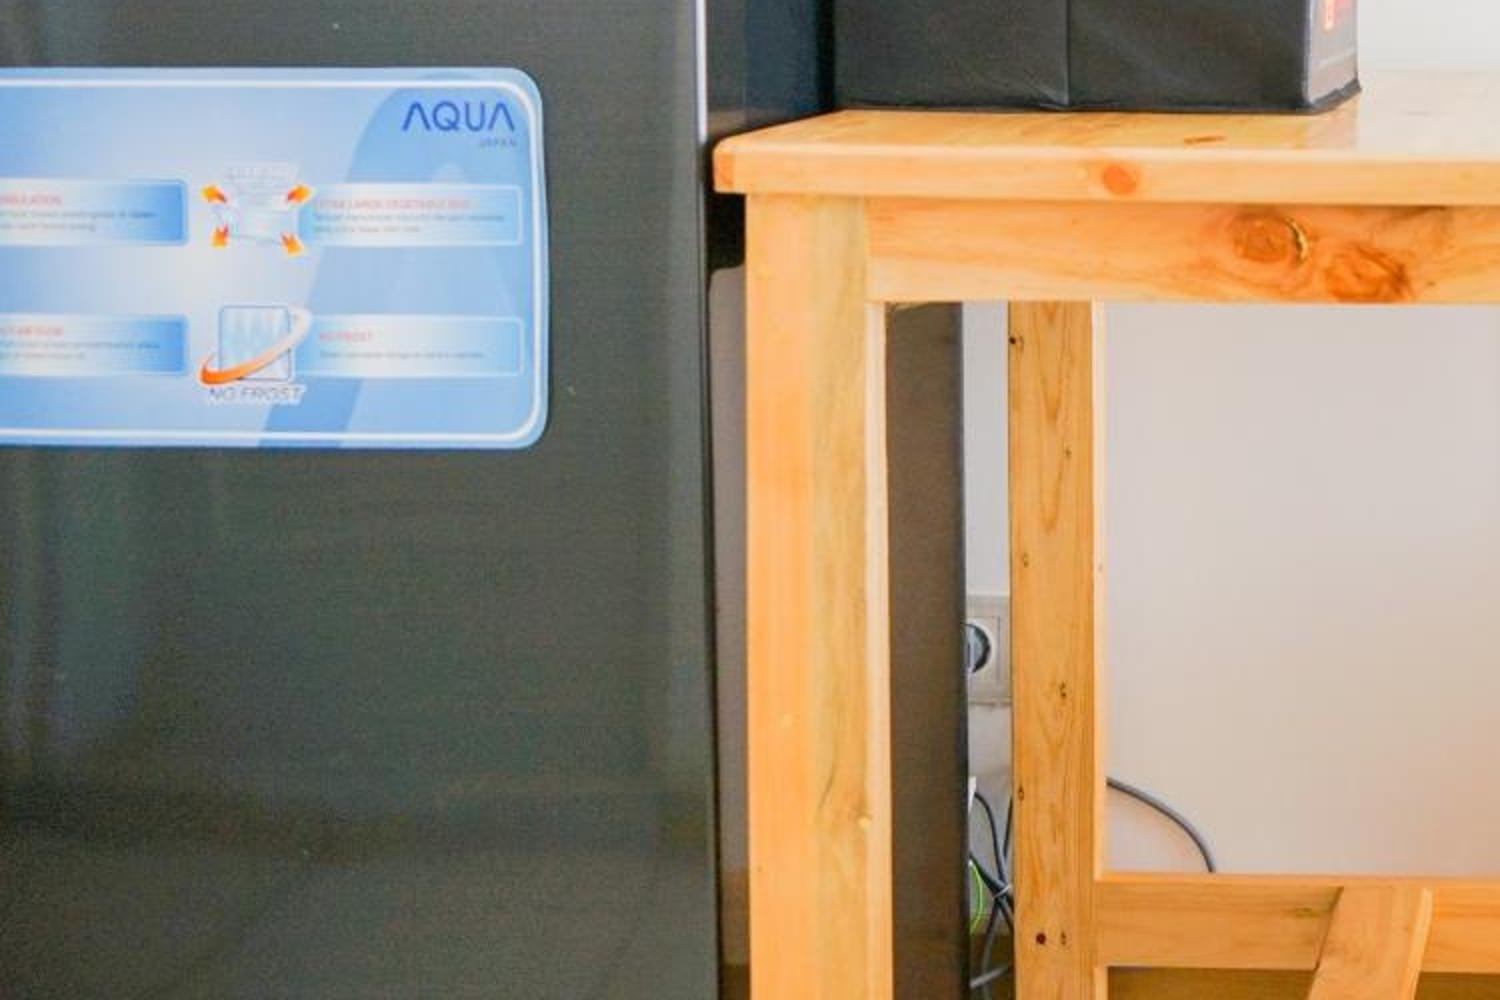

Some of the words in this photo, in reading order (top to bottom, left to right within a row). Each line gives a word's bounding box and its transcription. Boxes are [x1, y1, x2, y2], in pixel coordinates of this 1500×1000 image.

[402, 101, 515, 131] AQUA
[209, 386, 238, 402] NO
[241, 386, 302, 402] FROST
